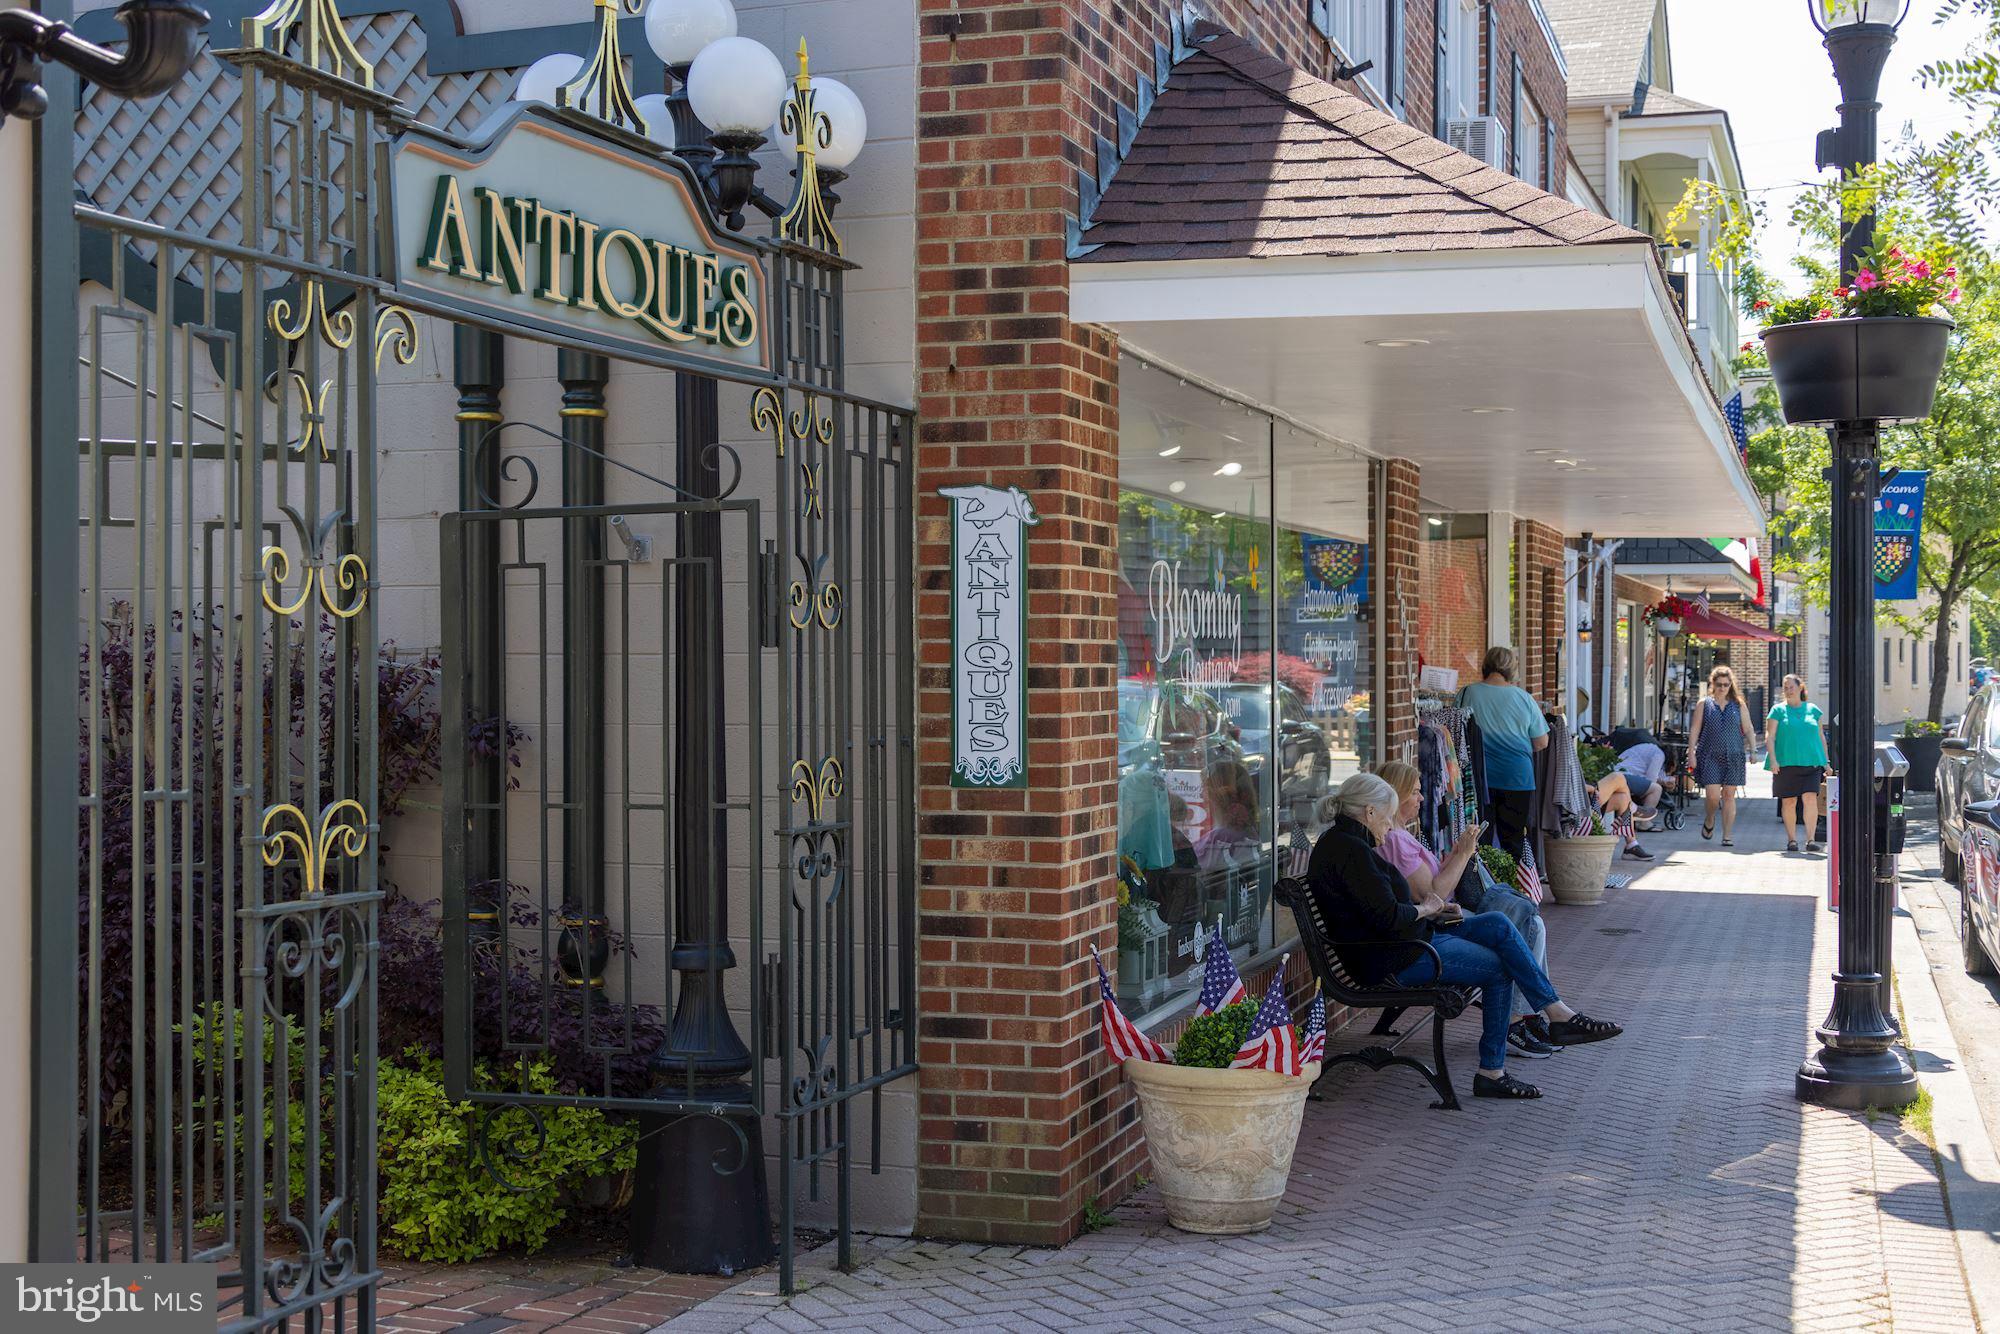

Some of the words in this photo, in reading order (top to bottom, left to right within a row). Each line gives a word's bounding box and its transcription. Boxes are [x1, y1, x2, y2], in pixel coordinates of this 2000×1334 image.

[417, 175, 758, 348] ANTIQUES
[1874, 535, 1907, 543] EWES
[1149, 560, 1241, 674] Blooming
[1303, 580, 1338, 620] Handbags
[1341, 584, 1359, 615] Shoes
[964, 532, 1013, 752] ANTIQUES
[1303, 630, 1333, 671] Clothing
[1335, 630, 1359, 669] Jewelry
[1180, 647, 1233, 705] Boutique
[1318, 679, 1353, 711] Accessories
